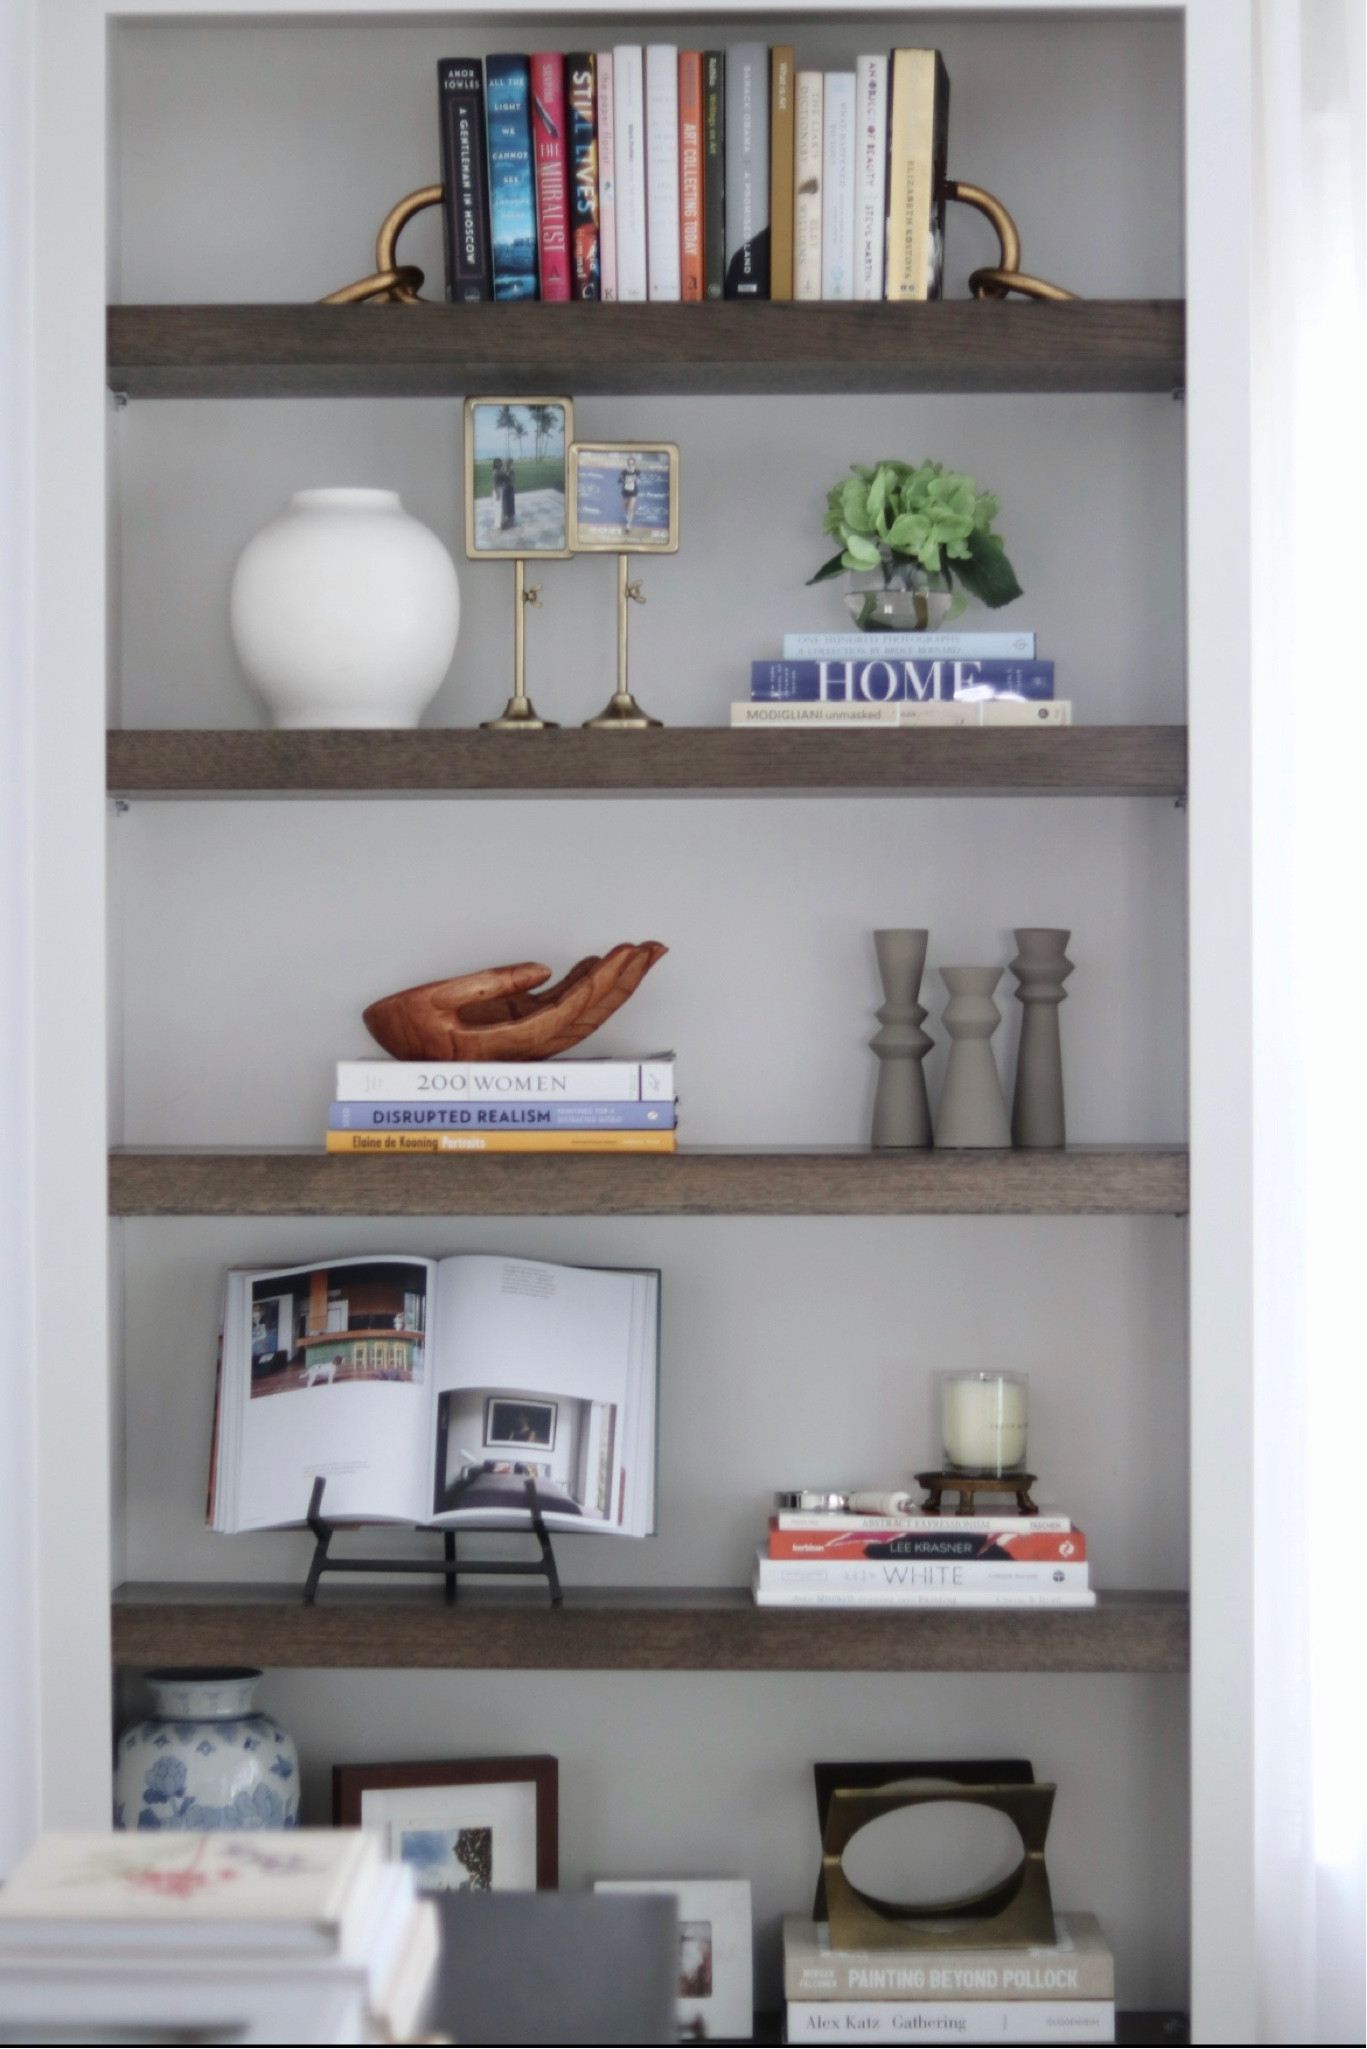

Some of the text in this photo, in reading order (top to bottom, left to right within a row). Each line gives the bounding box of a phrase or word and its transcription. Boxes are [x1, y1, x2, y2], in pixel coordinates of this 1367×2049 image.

[448, 70, 474, 79] AMOR
[708, 57, 717, 86] Rothko
[867, 62, 876, 77] AN
[444, 79, 480, 90] TOWLES
[489, 77, 524, 87] ALL THE
[778, 62, 788, 109] What is Art
[494, 102, 521, 112] LIGHT
[573, 70, 592, 133] STILL
[708, 92, 717, 126] Writings
[812, 92, 820, 116] THE
[600, 72, 611, 165] the paper florist
[798, 86, 809, 164] DICTIONARY
[839, 101, 848, 131] WHAT
[502, 127, 515, 135] WE
[683, 123, 697, 144] ART
[866, 125, 876, 141] OF
[492, 151, 528, 160] CANNOT
[709, 142, 717, 155] Art
[743, 65, 751, 274] BARACK OBAMA A PROMISED LAND
[865, 143, 875, 187] BEAUTY
[459, 107, 475, 265] A GENTLEMAN IN MOSCOW
[503, 176, 519, 184] SEE
[575, 144, 595, 214] LIVES
[684, 148, 698, 217] COLLECTING
[540, 143, 565, 252] THE MURALIST
[905, 159, 916, 226] ELIZABETH
[684, 221, 698, 256] TODAY
[798, 203, 809, 265] WILLIAMS
[864, 204, 874, 282] STEVE MARTIN
[903, 228, 914, 279] KOSTOVA
[798, 634, 961, 644] ONE HUNDRED PHOTOGRAPHS
[807, 646, 867, 655] COLLECTION
[918, 646, 961, 655] BERNARD
[815, 660, 982, 702] HOME
[746, 709, 882, 721] MODIGLIANI unmasked
[417, 1074, 567, 1091] 200 WOMEN
[373, 1109, 551, 1124] DISRUPTED REALISM
[353, 1135, 486, 1150] Elaine de Kooning Portraits
[862, 1519, 1061, 1529] ABSTRACT EXPRESSIONISM TASCHEN
[890, 1543, 973, 1553] LEE KRASNER
[882, 1566, 964, 1586] WHITE
[917, 1595, 957, 1605] Painting
[803, 1969, 835, 1979] MORGAN
[849, 1969, 1078, 1988] PAINTING BEYOND POLLOCK
[806, 2016, 840, 2030] Alex
[846, 2016, 880, 2030] Katz
[892, 2016, 967, 2032] Gathering
